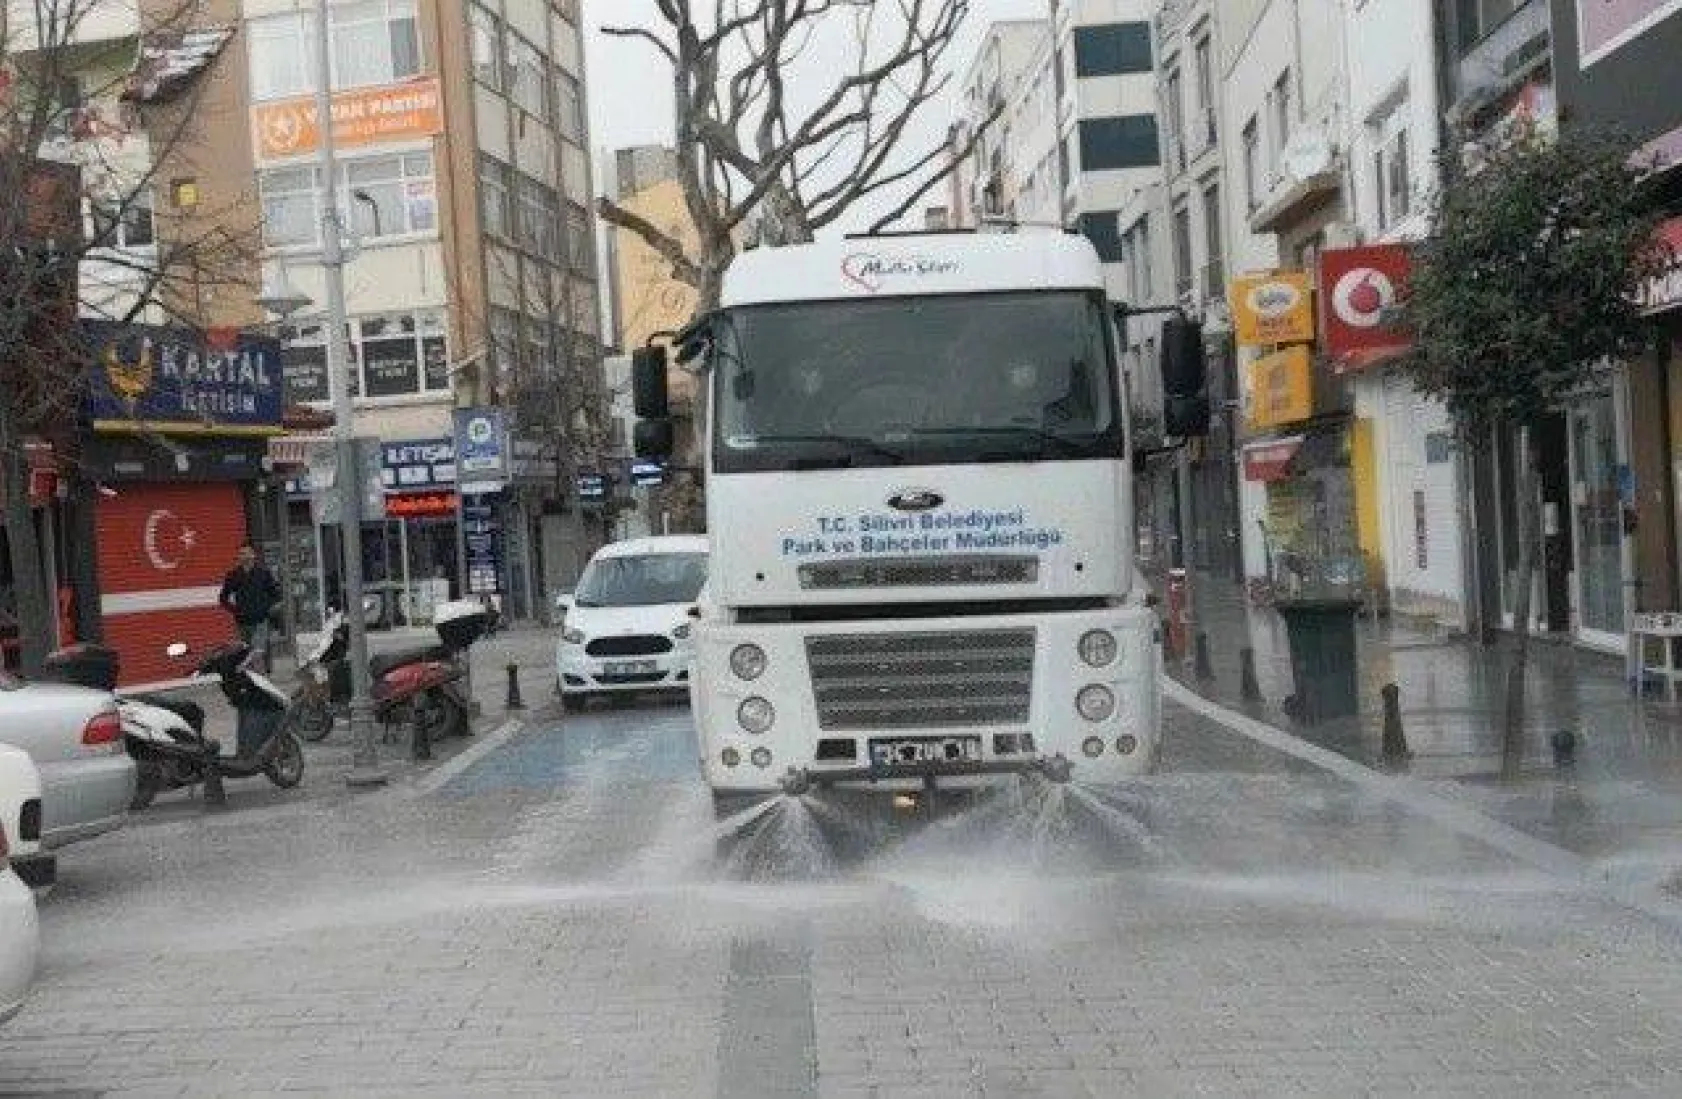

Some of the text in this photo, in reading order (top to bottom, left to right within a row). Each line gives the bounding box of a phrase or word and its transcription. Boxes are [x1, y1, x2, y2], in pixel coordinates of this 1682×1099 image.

[305, 101, 366, 124] VTAN
[161, 345, 270, 385] KARTAL
[816, 516, 853, 533] T.C.
[921, 507, 1023, 531] Belediyesi
[782, 538, 826, 555] Park
[832, 540, 855, 553] ve
[861, 533, 949, 555] Bahçeler
